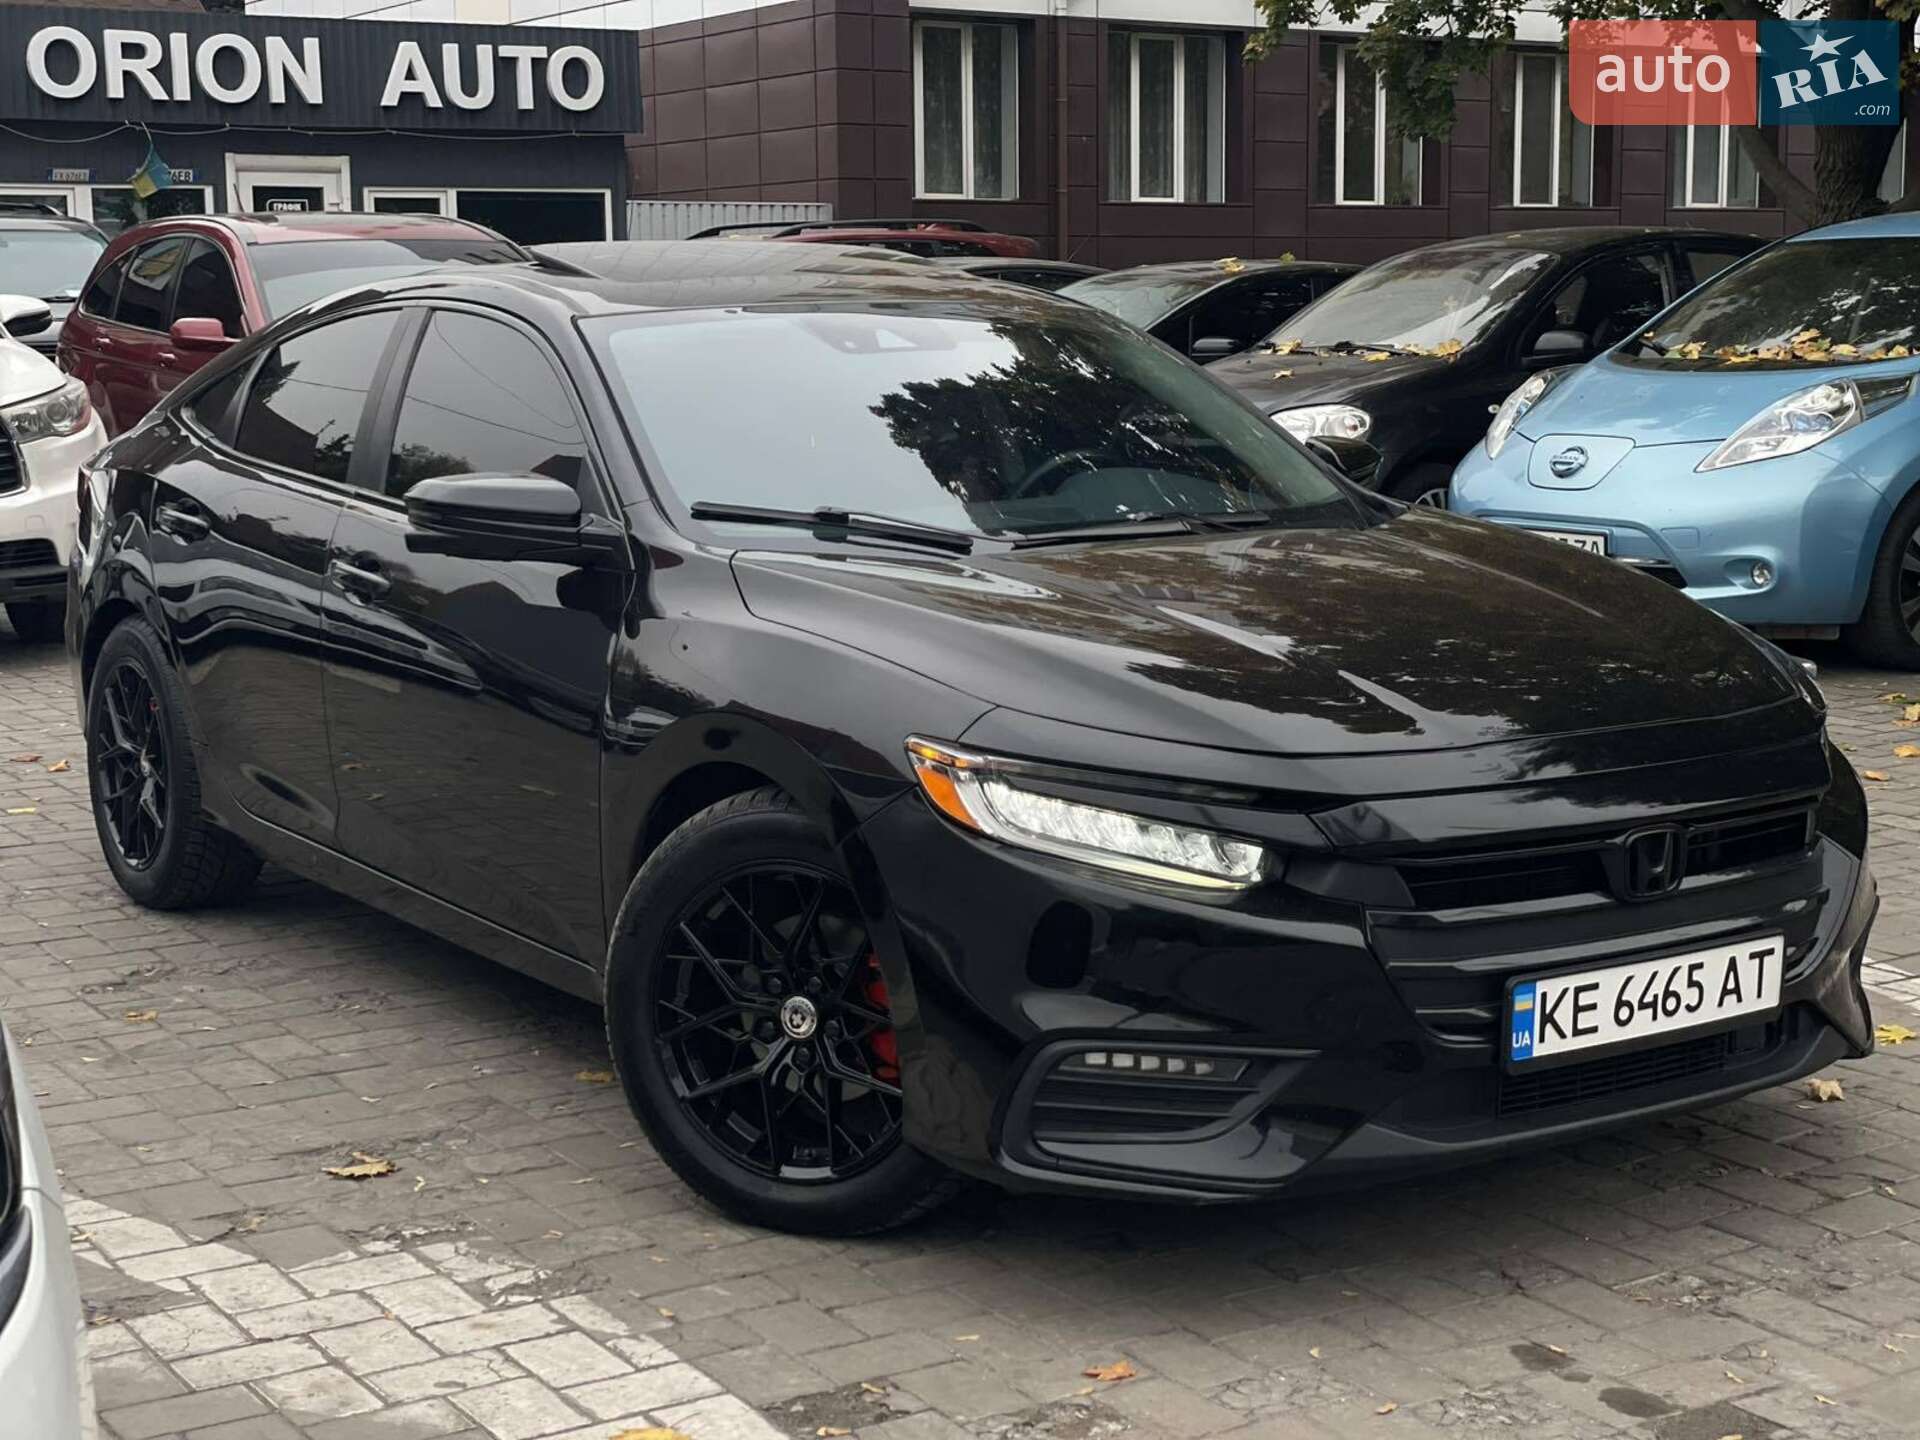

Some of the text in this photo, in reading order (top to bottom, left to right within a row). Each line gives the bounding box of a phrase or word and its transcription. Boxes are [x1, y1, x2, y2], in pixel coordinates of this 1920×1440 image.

[25, 26, 605, 111] ORION AUTO
[1538, 947, 1776, 1043] KE 6465 AT
[1512, 1031, 1531, 1049] UA
